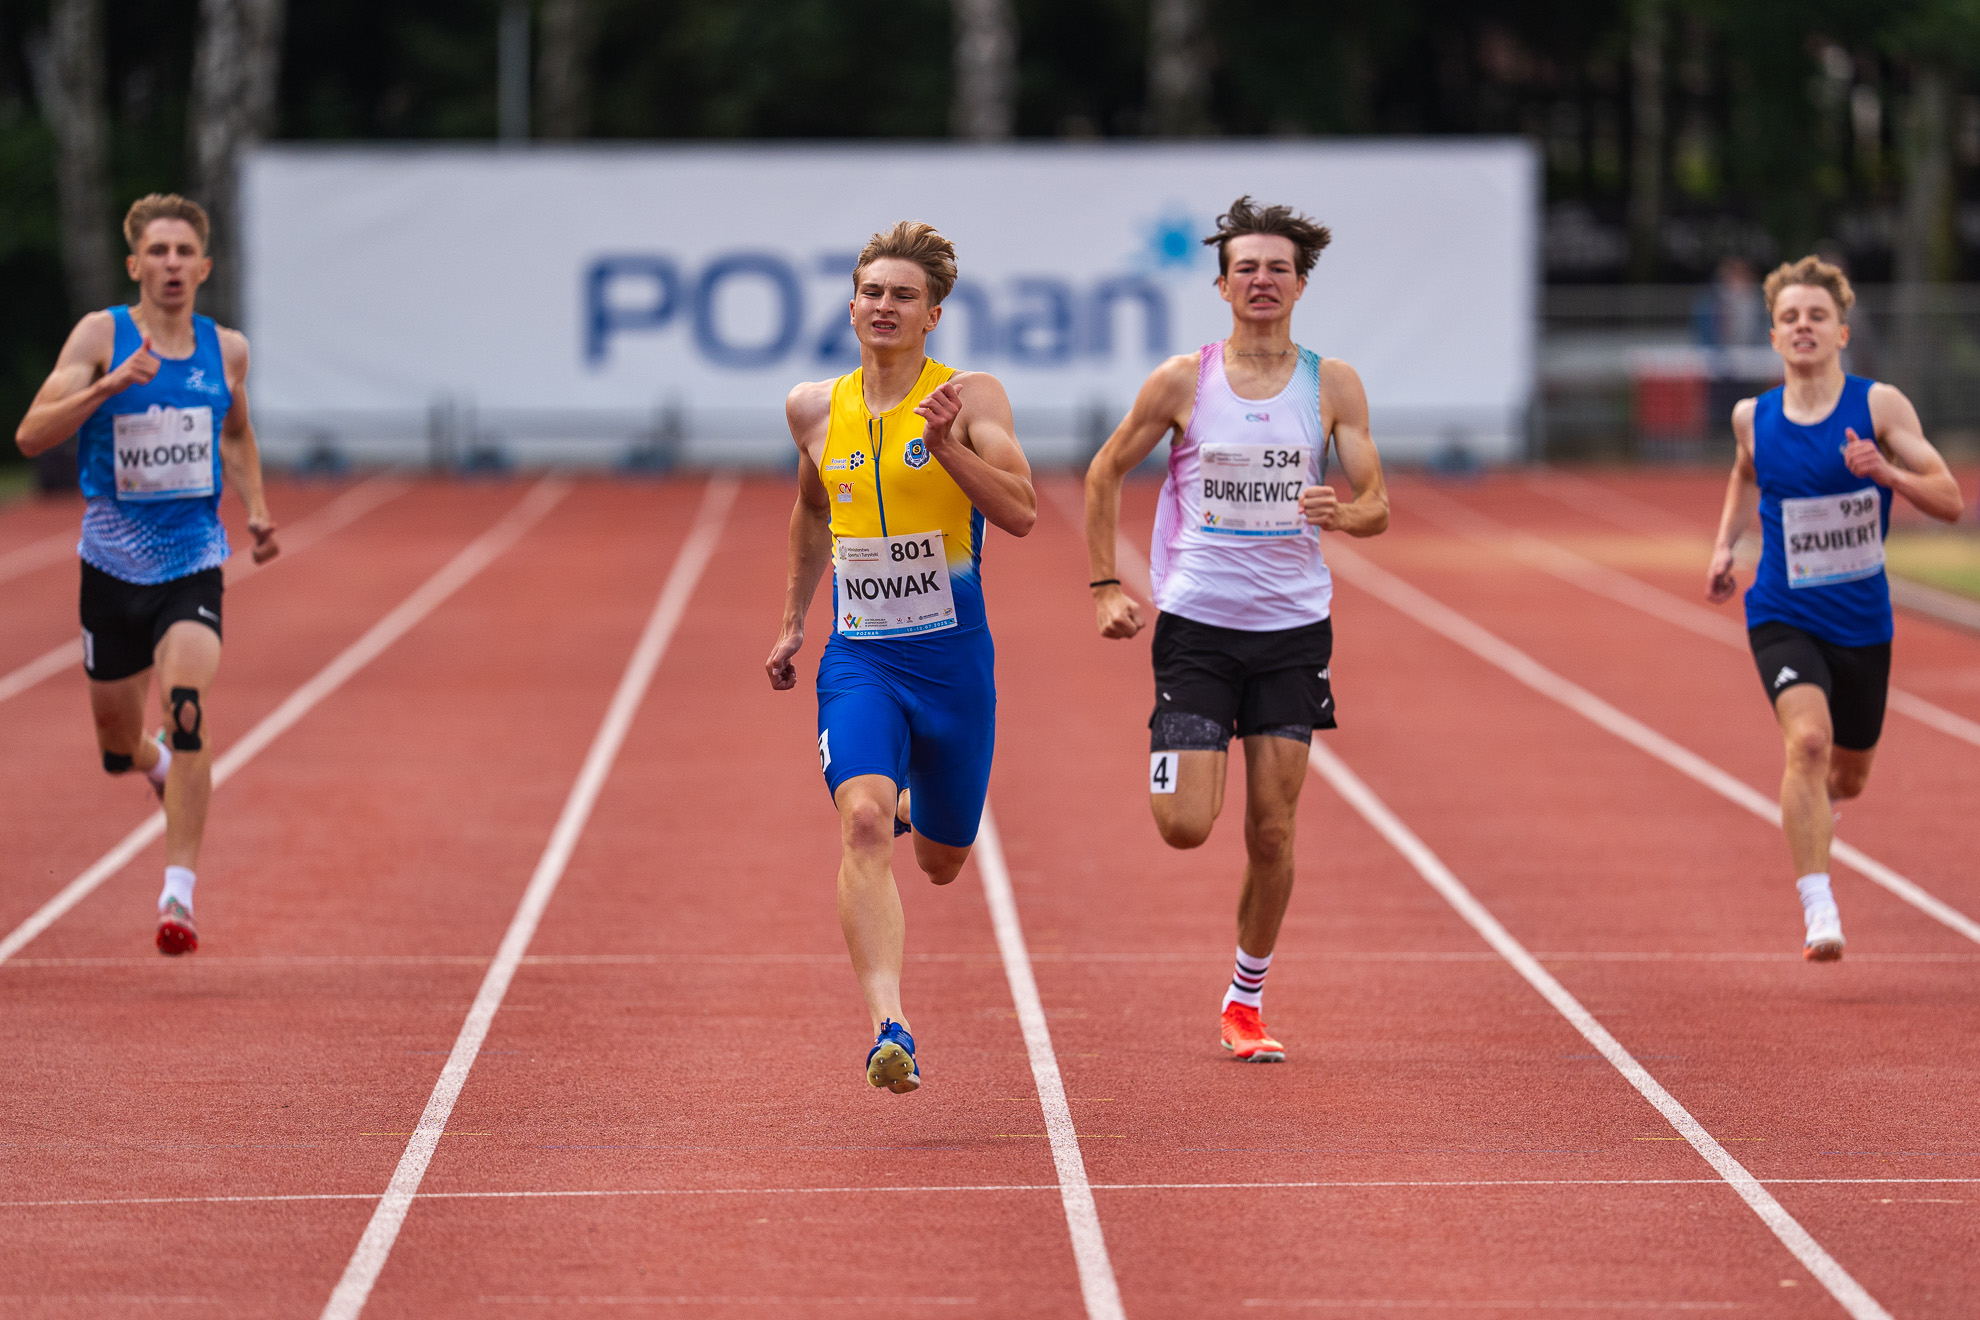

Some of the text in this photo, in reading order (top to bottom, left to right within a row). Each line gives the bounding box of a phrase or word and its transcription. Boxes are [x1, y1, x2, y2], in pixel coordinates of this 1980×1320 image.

[182, 414, 194, 432] 3
[1246, 412, 1269, 422] esa
[119, 442, 209, 469] WŁODEK
[1263, 450, 1300, 468] 534
[1204, 478, 1302, 502] BURKIEWICZ
[1790, 521, 1876, 555] SZUBERT
[890, 539, 935, 562] 801
[845, 570, 940, 600] NOWAK
[1153, 756, 1169, 790] 4
